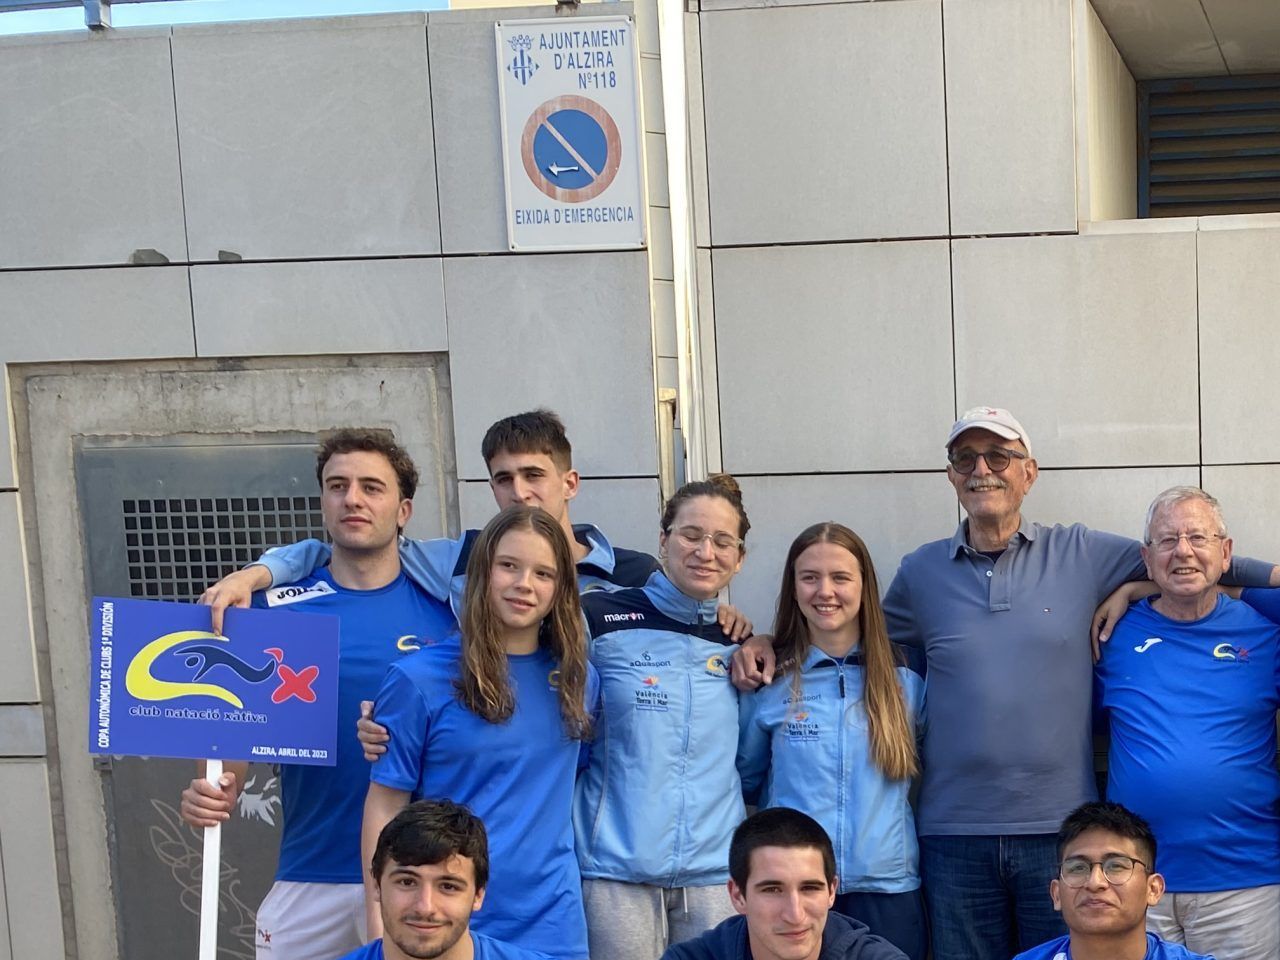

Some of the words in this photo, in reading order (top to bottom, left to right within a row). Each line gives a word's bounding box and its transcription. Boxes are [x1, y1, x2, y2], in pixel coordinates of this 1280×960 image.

[539, 29, 626, 50] AJUNTAMENT
[554, 51, 614, 70] D'ALZIRA
[515, 209, 550, 225] EIXIDA
[554, 206, 634, 223] D'EMERGENCIA
[98, 601, 114, 637] DIVISIÓN
[604, 612, 645, 622] macron
[100, 646, 113, 669] CLUBS
[100, 669, 111, 679] DE
[95, 680, 111, 728] AUTONÓMICA
[129, 705, 161, 717] club
[165, 707, 221, 721] natació
[223, 710, 268, 724] xàtiva
[97, 728, 110, 748] COPA
[251, 746, 277, 757] ALZIRA,
[278, 747, 298, 758] ABRIL
[298, 748, 311, 758] DEL
[311, 749, 329, 759] 2023
